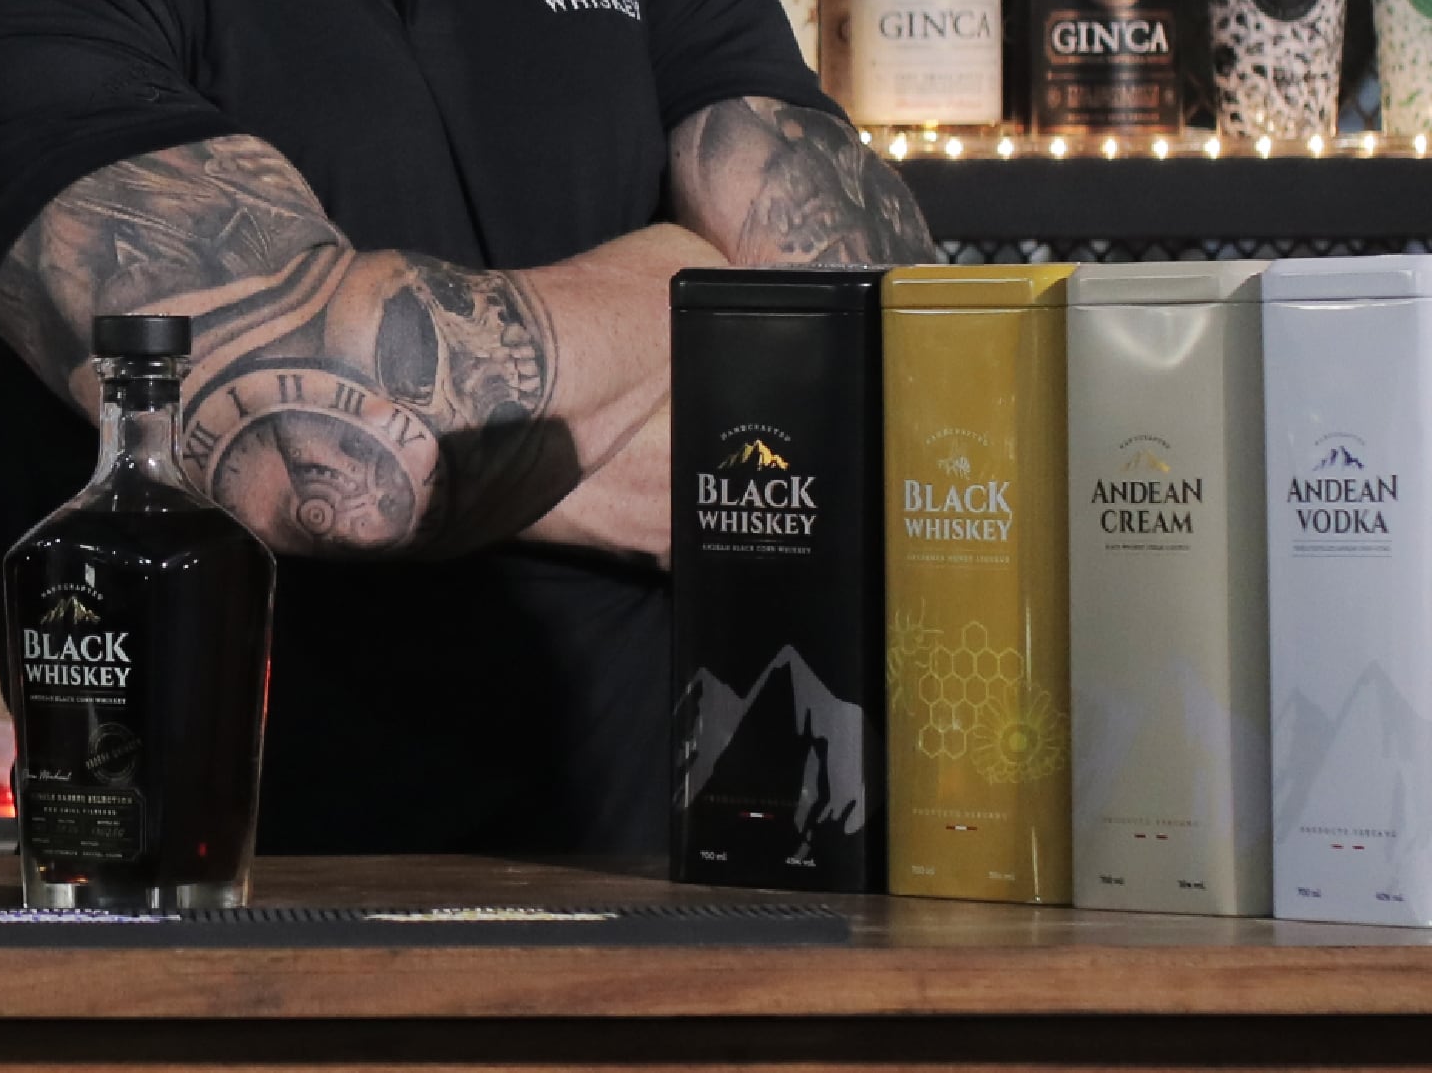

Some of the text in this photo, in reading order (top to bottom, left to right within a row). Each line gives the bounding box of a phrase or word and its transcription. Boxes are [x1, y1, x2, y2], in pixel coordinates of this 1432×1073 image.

[696, 472, 818, 509] BLACK
[904, 479, 1013, 513] BLACK
[1090, 478, 1203, 504] ANDEAN
[1287, 474, 1399, 504] ANDEAN
[697, 510, 817, 535] WHISKEY
[904, 517, 1012, 542] WHISKEY
[1100, 509, 1194, 534] CREAM
[1296, 508, 1389, 534] VODKA
[23, 628, 132, 663] BLACK
[24, 663, 132, 688] WHISKEY
